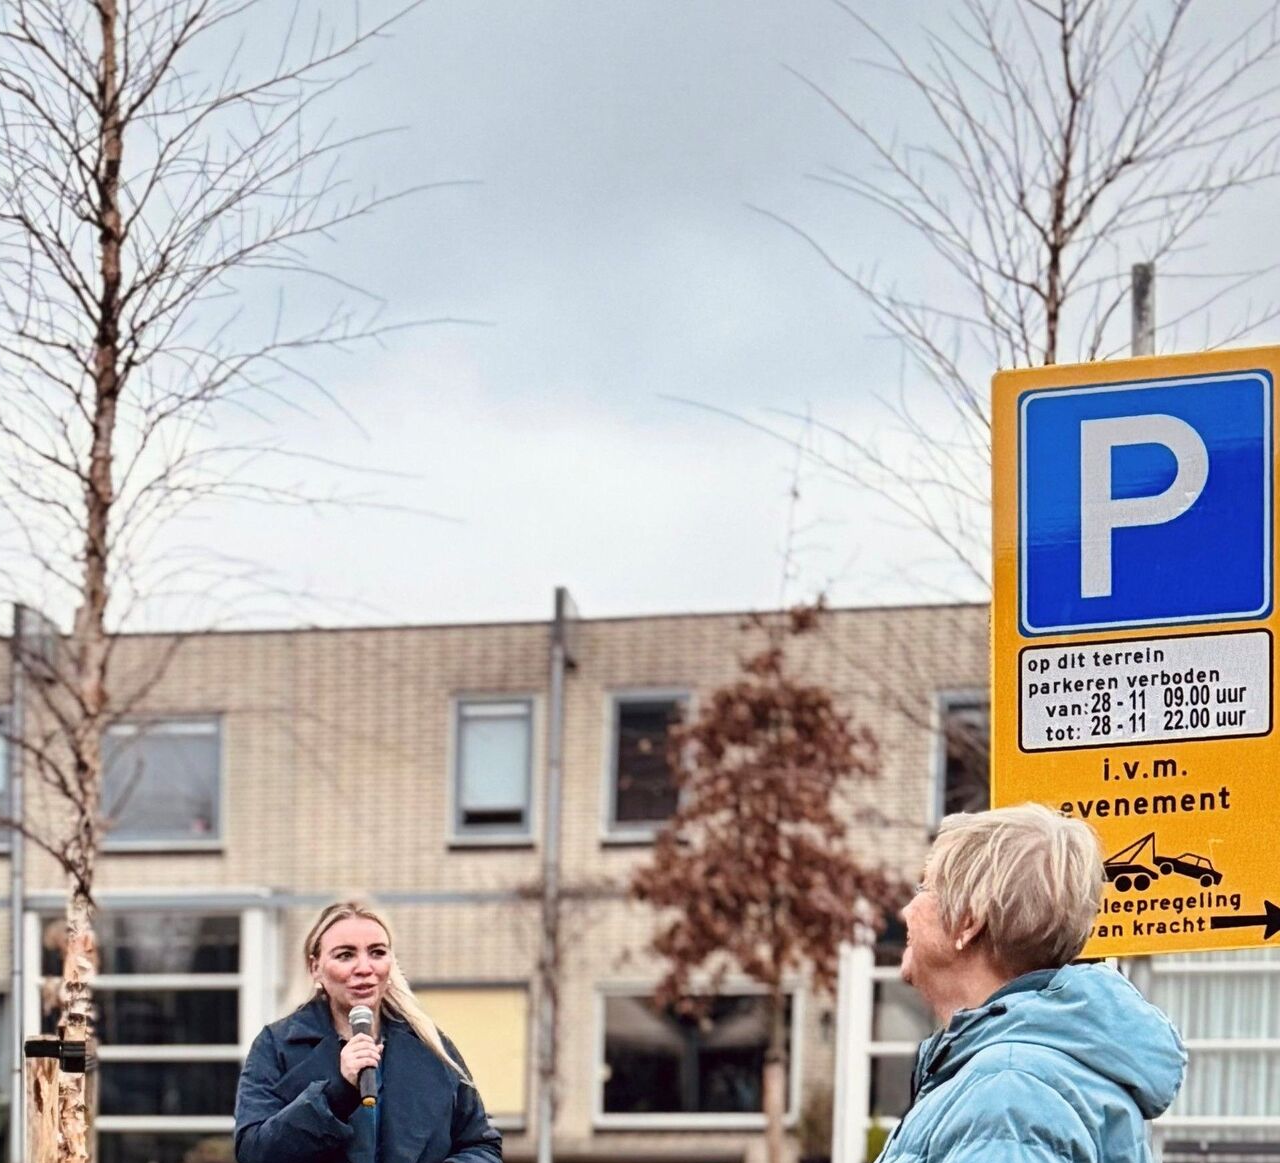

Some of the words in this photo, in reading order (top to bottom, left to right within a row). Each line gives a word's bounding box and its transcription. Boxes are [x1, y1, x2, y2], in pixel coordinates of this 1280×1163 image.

[1080, 412, 1210, 599] P
[1028, 659, 1050, 673] op
[1058, 653, 1086, 670] dit
[1093, 647, 1165, 666] terrein
[1029, 675, 1119, 698] parkeren
[1127, 668, 1220, 688] verboden
[1045, 701, 1089, 718] van:
[1091, 692, 1111, 713] 28
[1129, 689, 1146, 710] 11
[1163, 684, 1210, 708] 09.00
[1216, 686, 1246, 704] uur
[1045, 726, 1081, 742] tot:
[1091, 715, 1111, 736] 28
[1129, 712, 1146, 733] 11
[1163, 707, 1210, 731] 22.00
[1216, 708, 1246, 727] uur
[1103, 758, 1188, 781] i.v.m.
[1060, 786, 1231, 818] evenement
[1096, 892, 1241, 914] leepregeling
[1133, 916, 1206, 935] kracht
